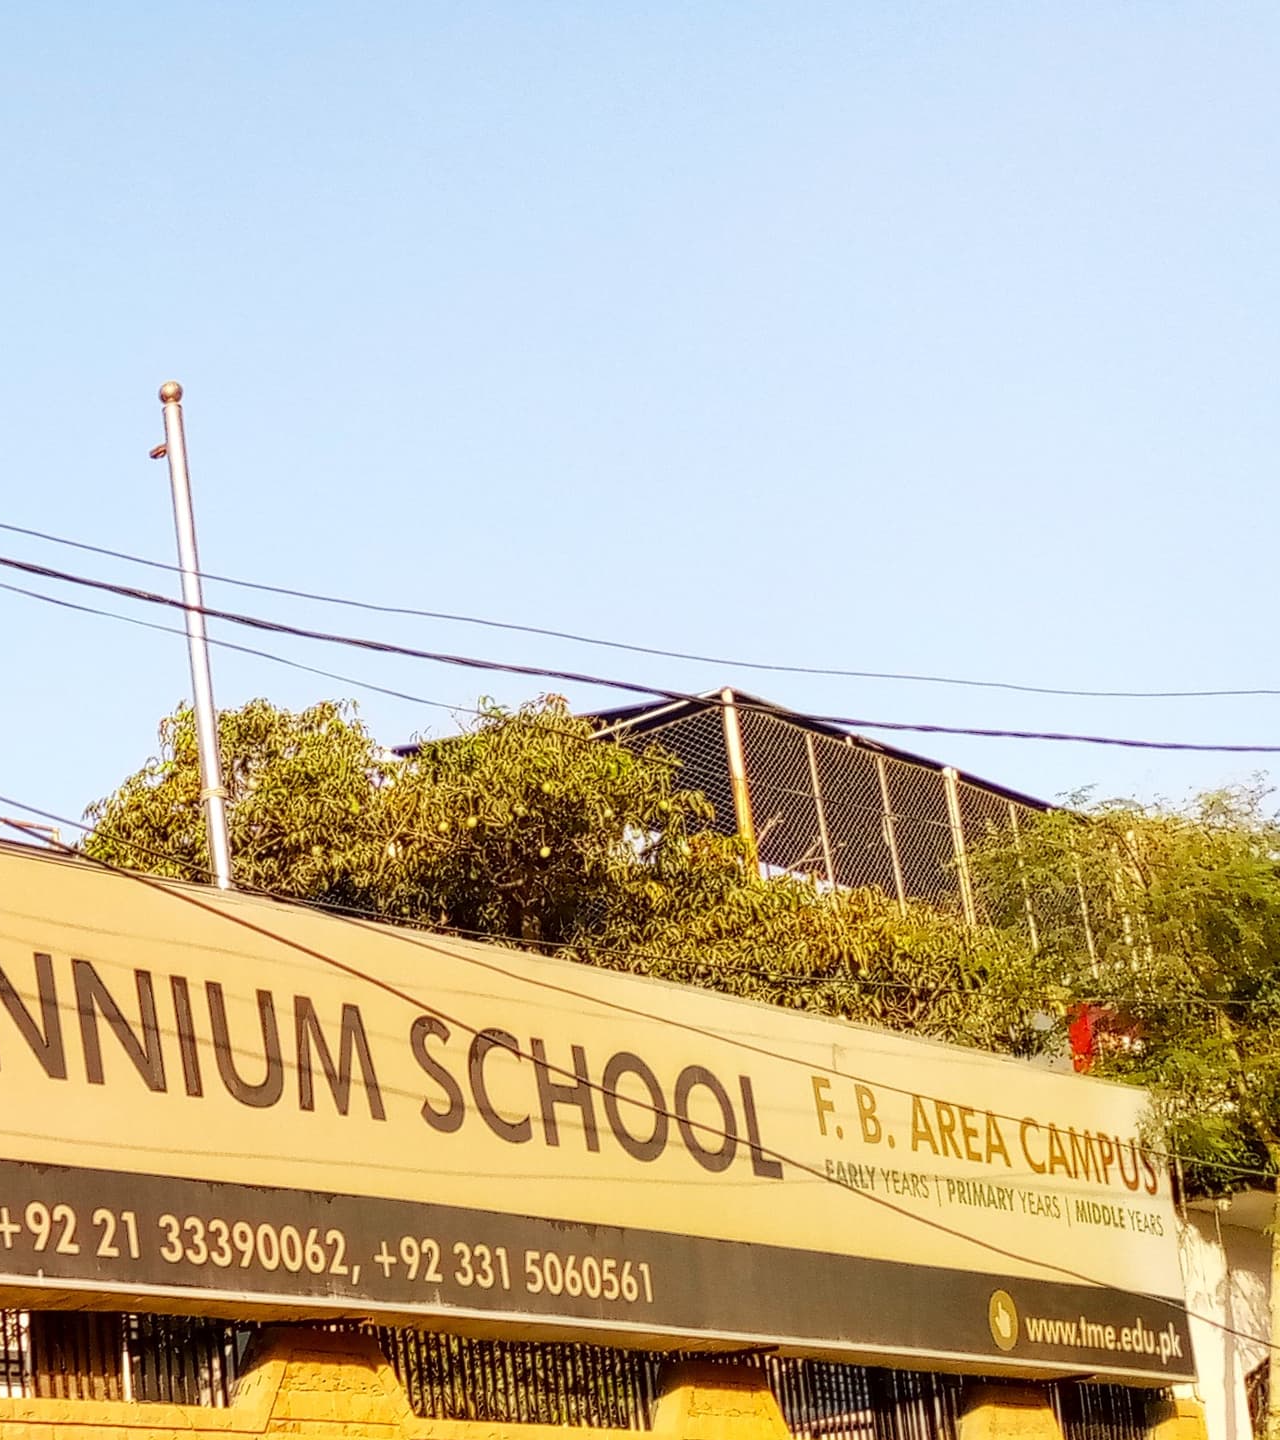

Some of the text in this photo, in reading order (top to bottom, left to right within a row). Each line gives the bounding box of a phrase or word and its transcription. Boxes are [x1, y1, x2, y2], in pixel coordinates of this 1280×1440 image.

[409, 1014, 784, 1180] SCHOOL
[911, 1094, 1012, 1168] AREA
[1019, 1117, 1158, 1196] CAMPUS
[825, 1159, 1165, 1237] EARLY YEARS PRIMARY YEARS MIDDLE YEARS
[92, 1207, 140, 1259] 21
[157, 1213, 361, 1285] 33390062,
[373, 1235, 443, 1283] +92
[452, 1241, 511, 1290] 331
[525, 1250, 654, 1303] 5060561
[1025, 1315, 1184, 1365] www.tme.edu.pk
